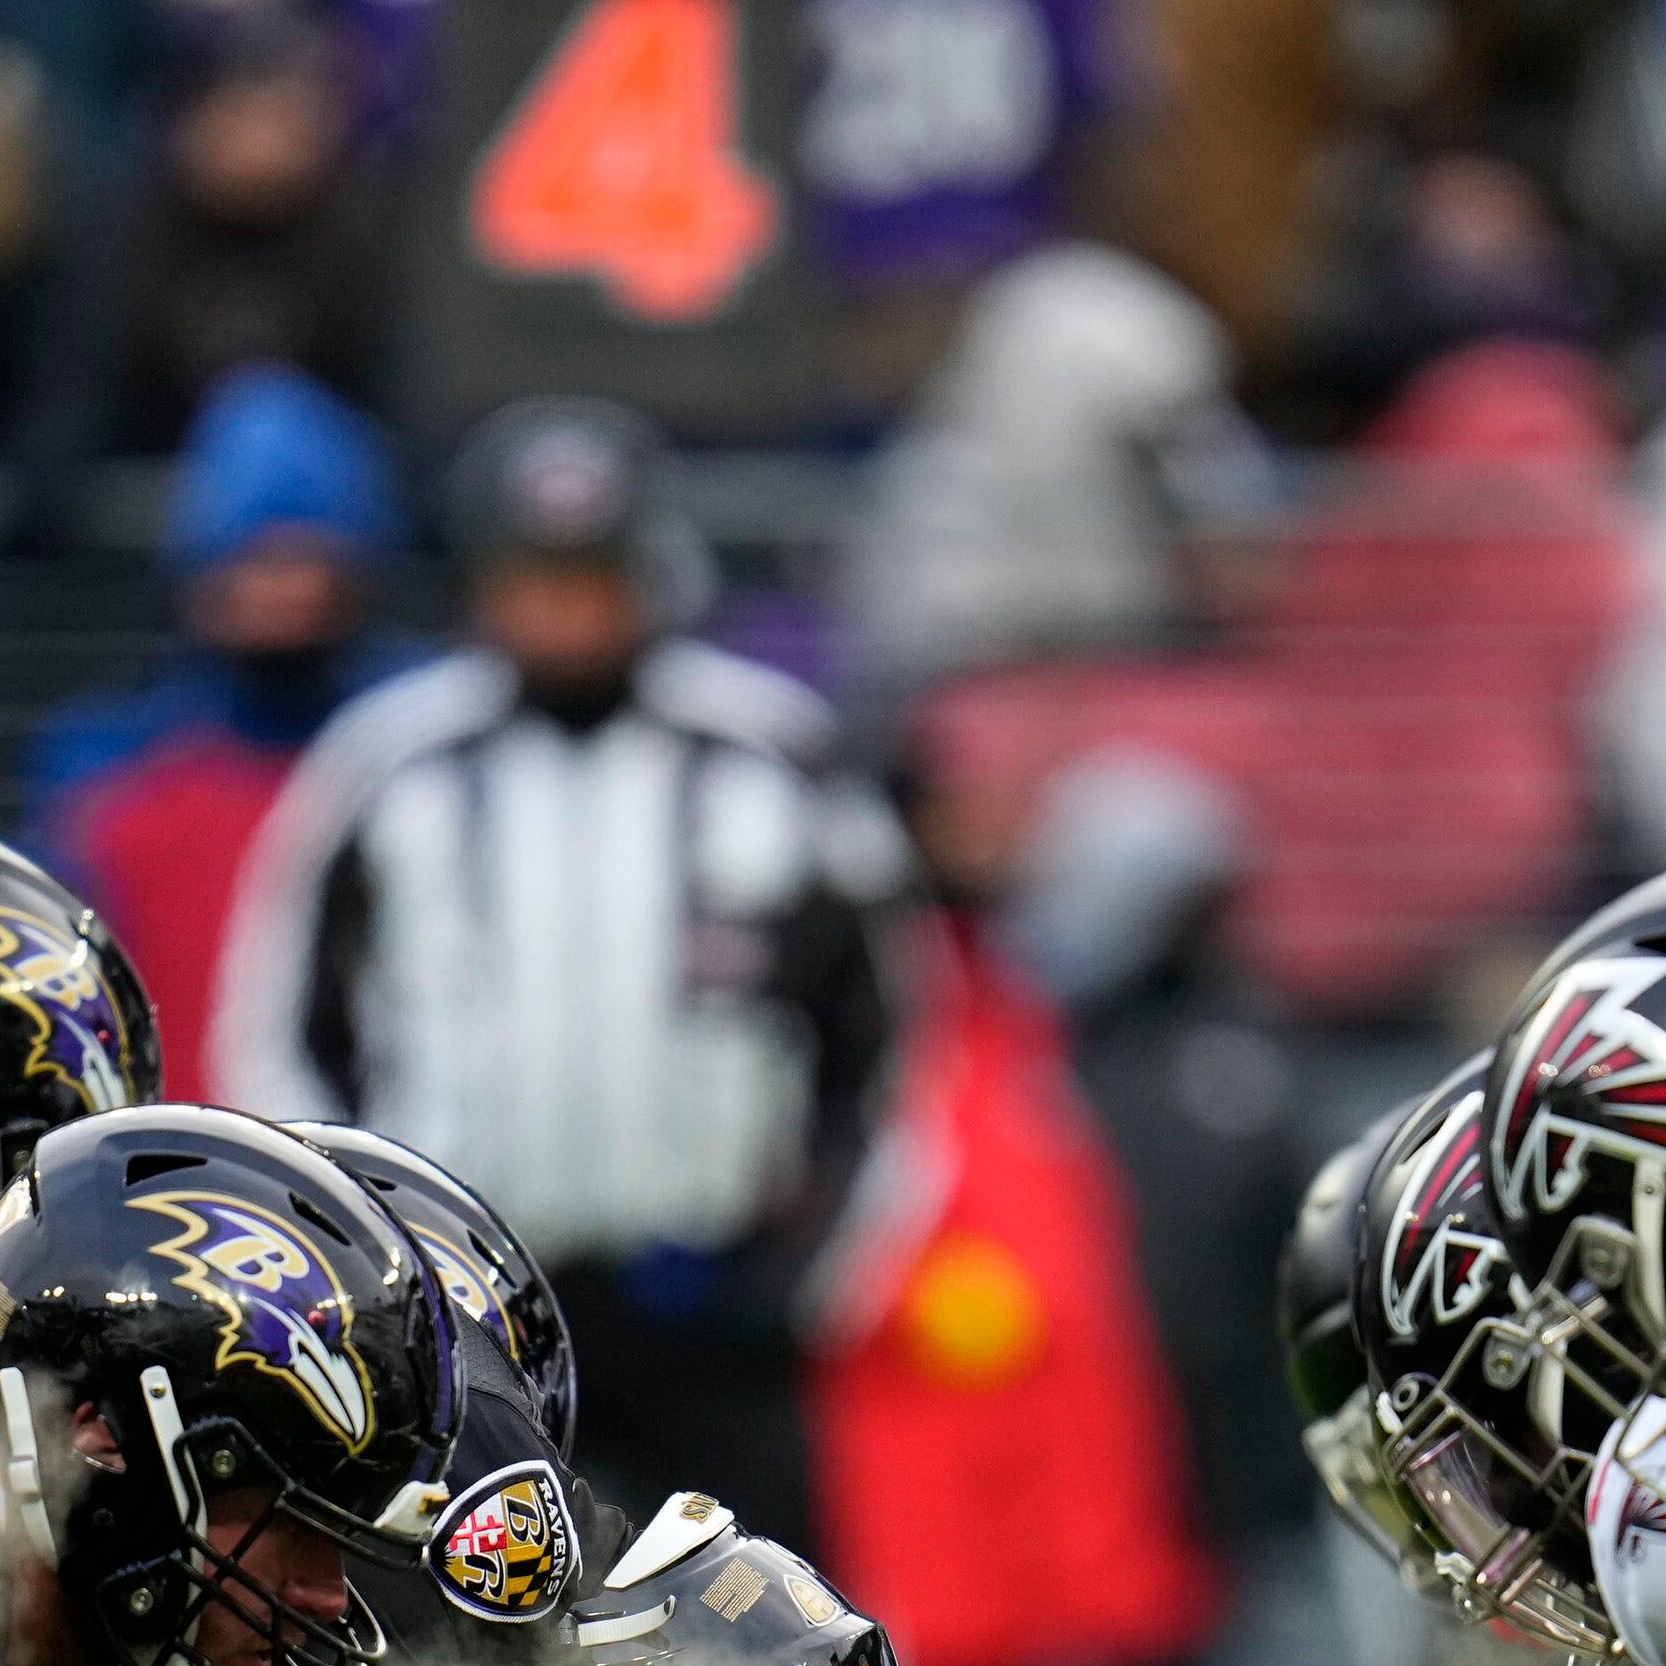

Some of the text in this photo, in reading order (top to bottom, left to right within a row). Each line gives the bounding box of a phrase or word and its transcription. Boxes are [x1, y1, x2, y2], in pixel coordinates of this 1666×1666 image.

[470, 0, 779, 322] 4
[199, 1207, 311, 1294] B
[503, 1482, 548, 1547] B
[538, 1477, 567, 1597] RAVENS
[462, 1549, 506, 1599] R
